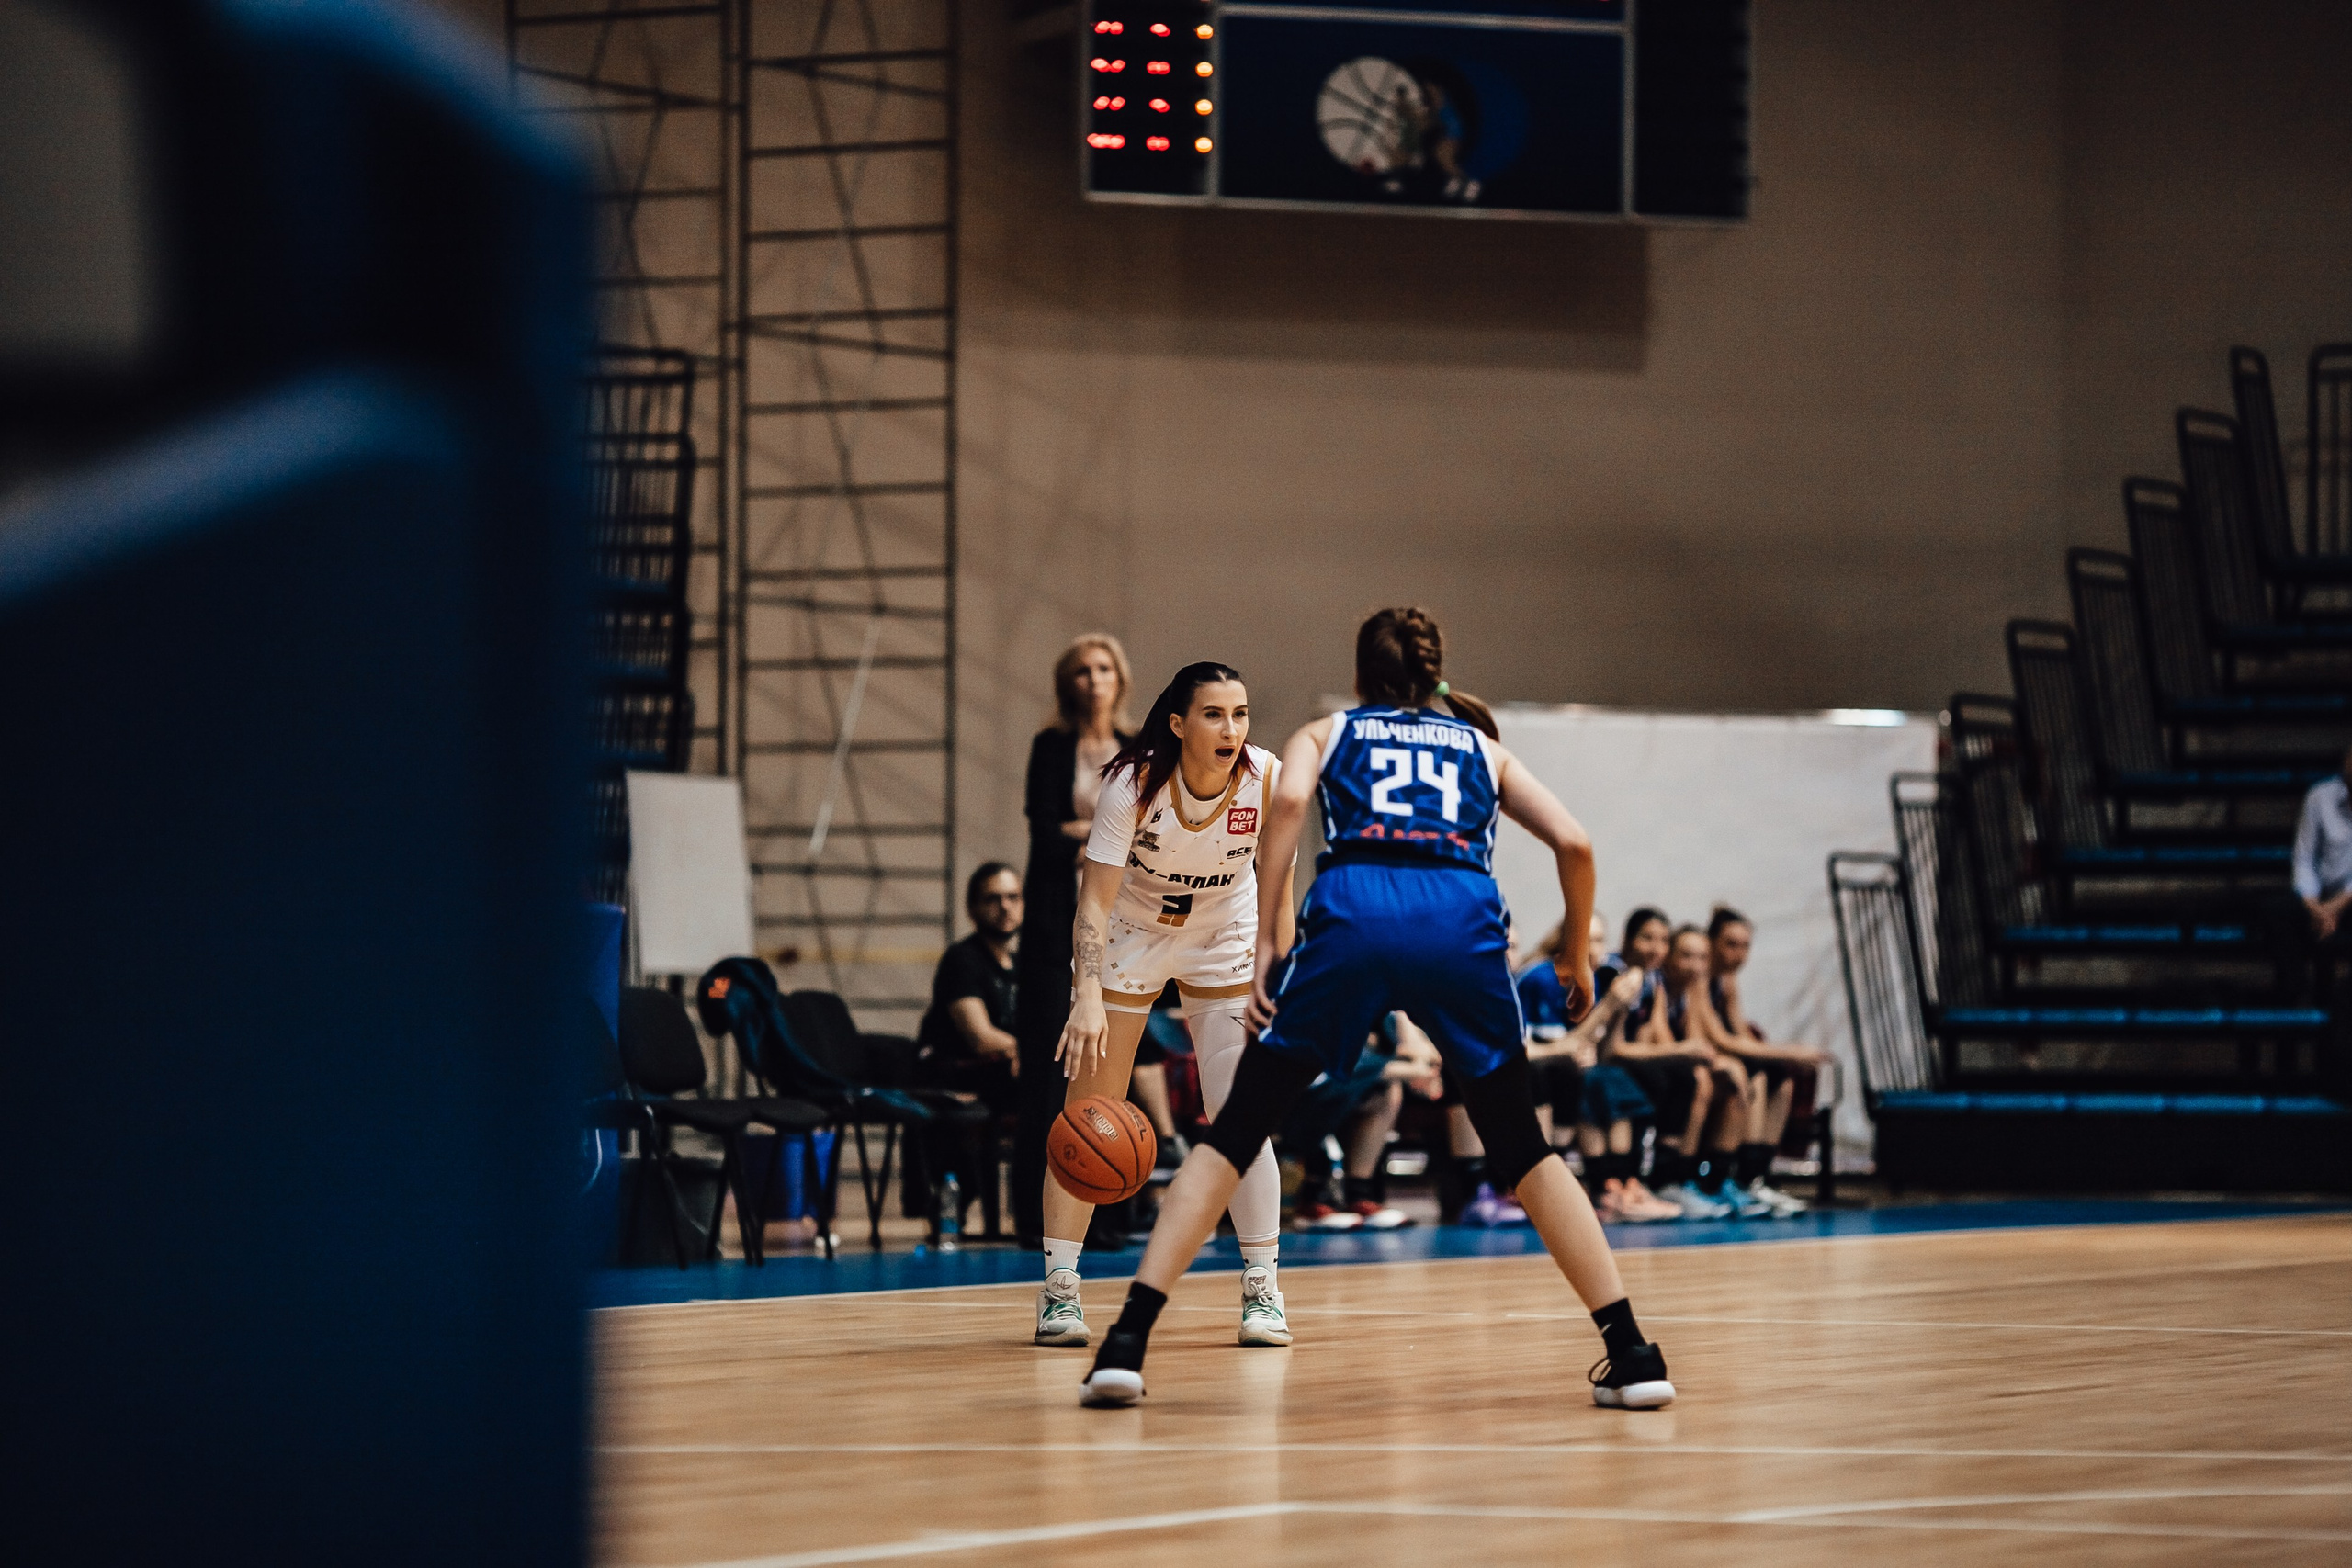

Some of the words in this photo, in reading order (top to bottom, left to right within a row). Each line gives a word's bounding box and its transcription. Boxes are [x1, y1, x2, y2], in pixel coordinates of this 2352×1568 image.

[1352, 717, 1475, 755] УЛЬЧЕНКОВА
[1369, 746, 1462, 824] 24
[1228, 820, 1255, 831] BET
[1229, 810, 1256, 821] FON
